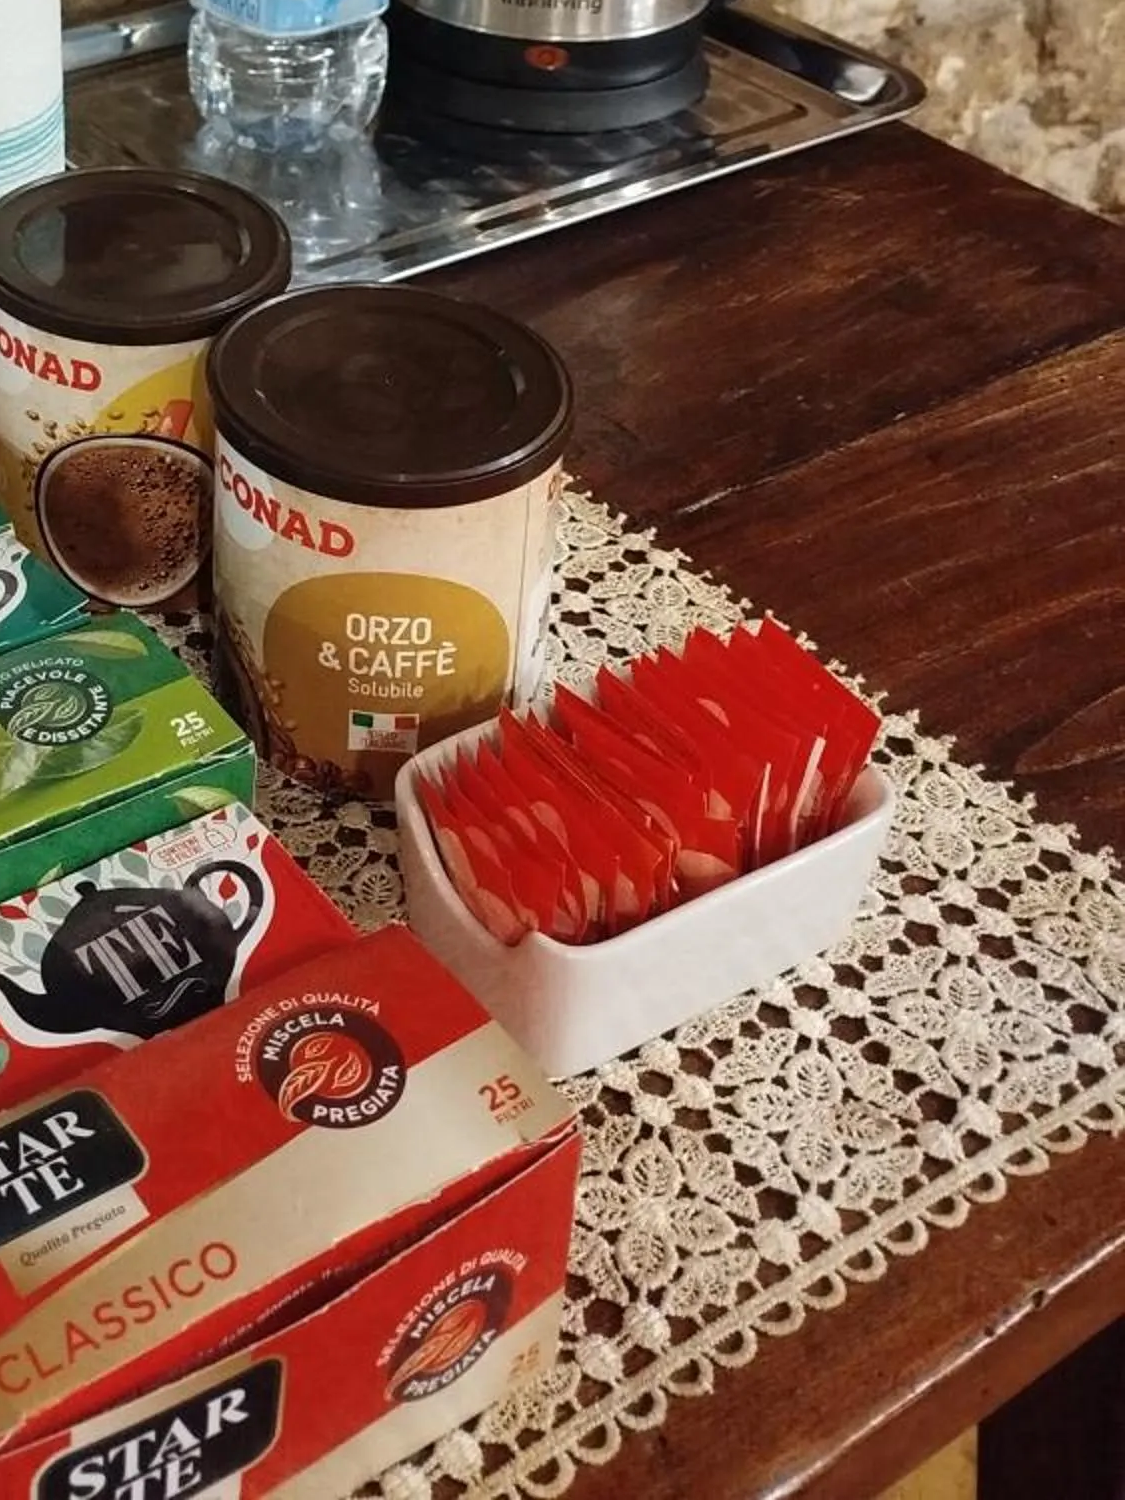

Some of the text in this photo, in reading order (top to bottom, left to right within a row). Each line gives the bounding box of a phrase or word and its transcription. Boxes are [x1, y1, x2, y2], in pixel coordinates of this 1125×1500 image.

[221, 454, 356, 558] CONAD
[346, 613, 432, 645] ORZO
[11, 657, 84, 675] DELICATO
[318, 641, 458, 679] & CAFFÈ
[0, 669, 88, 709] PIACEVOLE
[37, 684, 109, 743] DISSETANTE
[347, 678, 425, 699] Solubile
[170, 711, 206, 738] 25
[235, 1006, 280, 1084] SELEZIONE
[278, 998, 299, 1011] DI
[262, 1011, 346, 1062] MISCELA
[312, 1064, 400, 1124] PREGIATA
[478, 1074, 522, 1112] 25
[410, 1273, 497, 1339] MISCELA
[401, 1328, 497, 1397] PREGIATA
[68, 1387, 250, 1500] STAR
